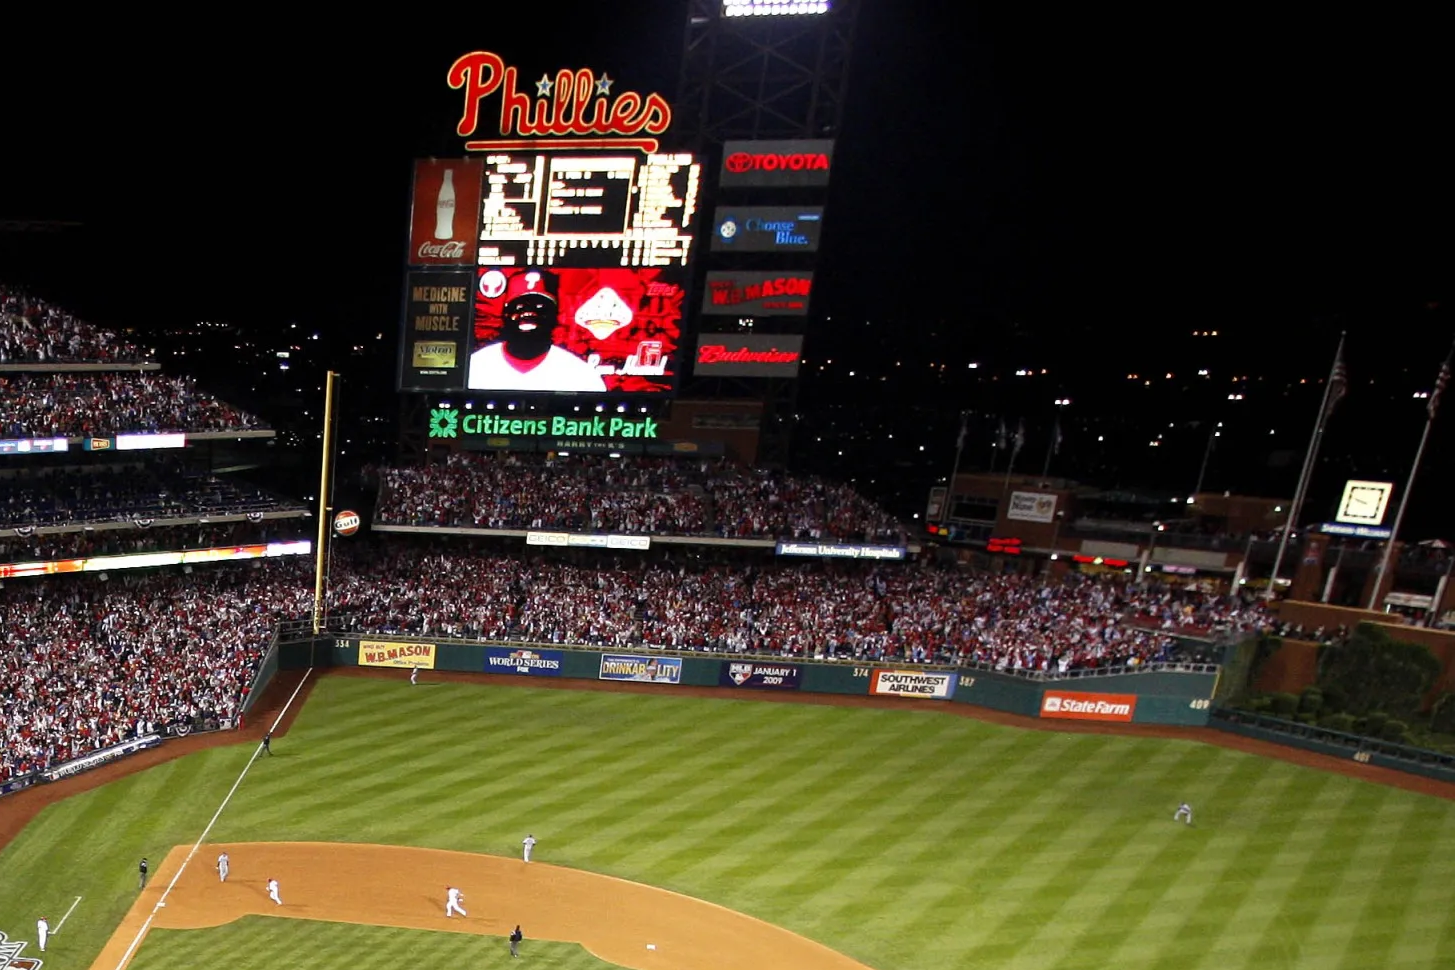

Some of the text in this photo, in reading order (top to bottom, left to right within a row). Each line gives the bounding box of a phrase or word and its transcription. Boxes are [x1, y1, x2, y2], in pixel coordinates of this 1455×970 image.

[447, 51, 671, 136] Phillies
[752, 153, 829, 171] TOYOTA
[418, 241, 466, 259] Coca-Cola
[415, 316, 460, 331] MUSCLE
[698, 345, 799, 364] Budweiser
[462, 414, 657, 438] Citizens Bank Park
[336, 517, 357, 529] Gulf
[529, 534, 566, 543] GEICO
[489, 657, 559, 669] WORLD SERIES
[602, 661, 679, 677] DRINKABLITY
[753, 667, 797, 677] JANUARY 1
[763, 676, 783, 684] 2009
[881, 674, 946, 685] SOUTHWEST
[889, 684, 935, 694] AIRLINES
